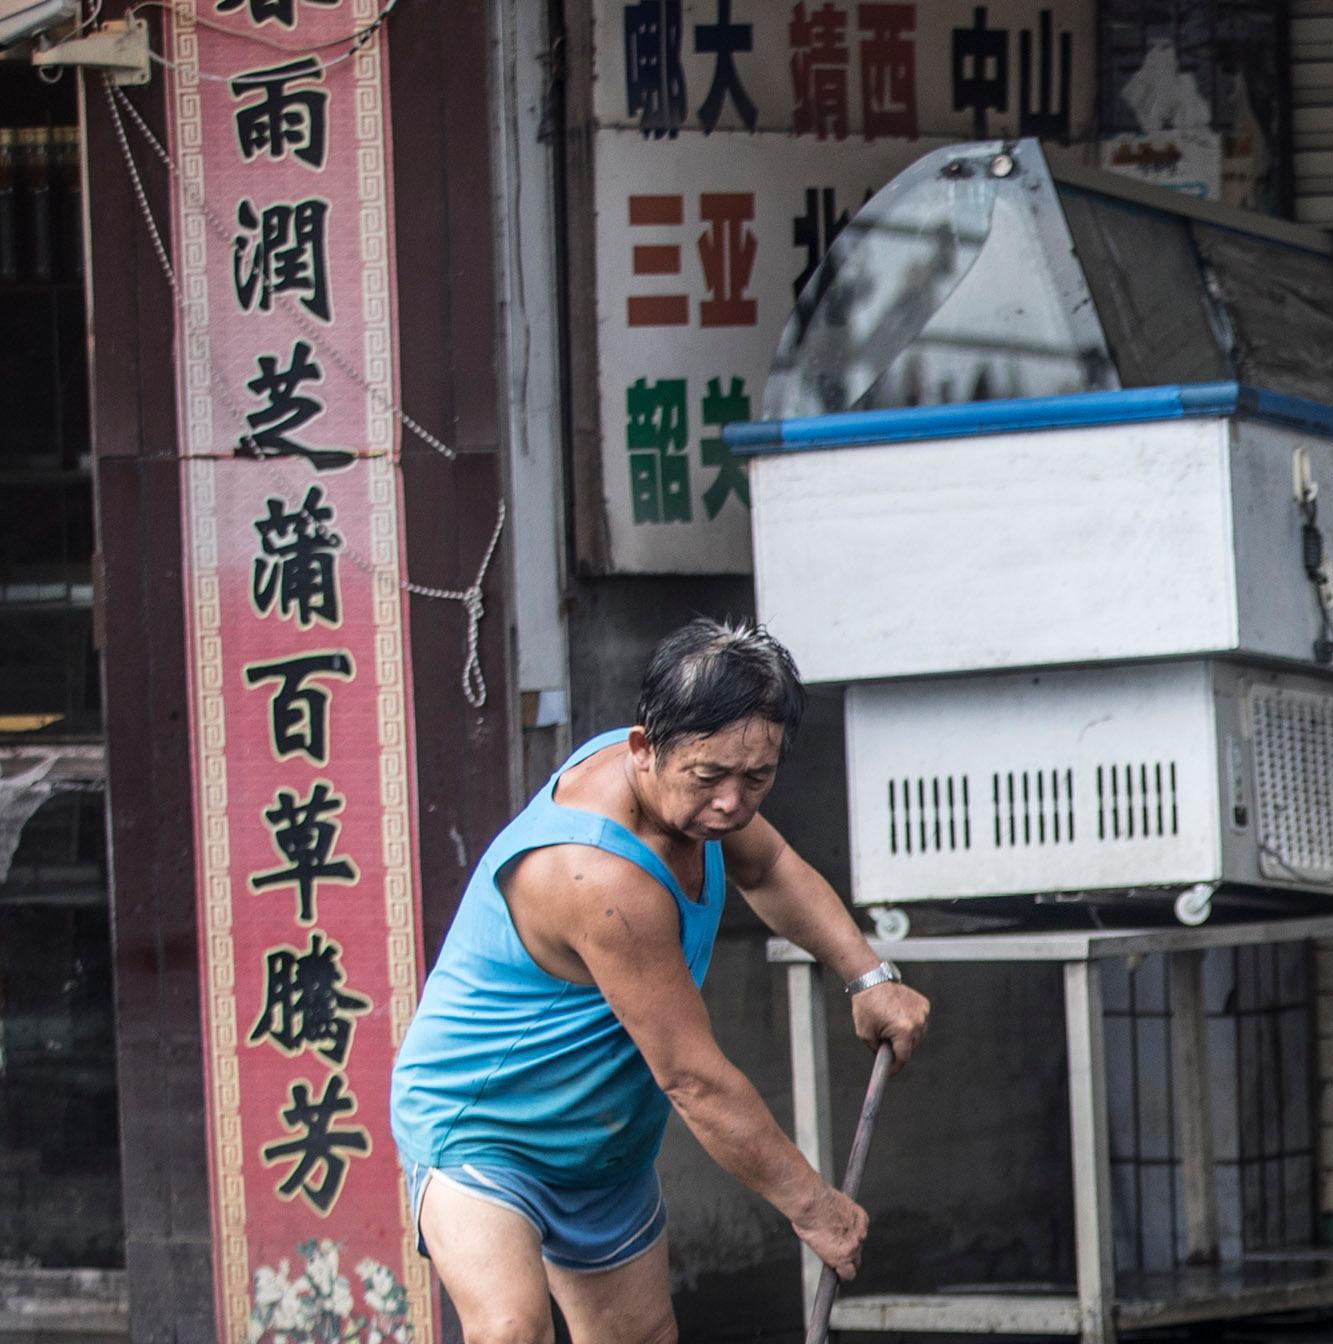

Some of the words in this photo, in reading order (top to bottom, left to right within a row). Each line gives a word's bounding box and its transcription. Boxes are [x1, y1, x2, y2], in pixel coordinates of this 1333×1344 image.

[789, 3, 917, 141] 靖西
[951, 7, 1073, 140] 中山
[627, 192, 759, 328] 三亚
[626, 374, 752, 525] 韶关
[216, 0, 369, 1212] 雨潤芝蒲百草騰芳
